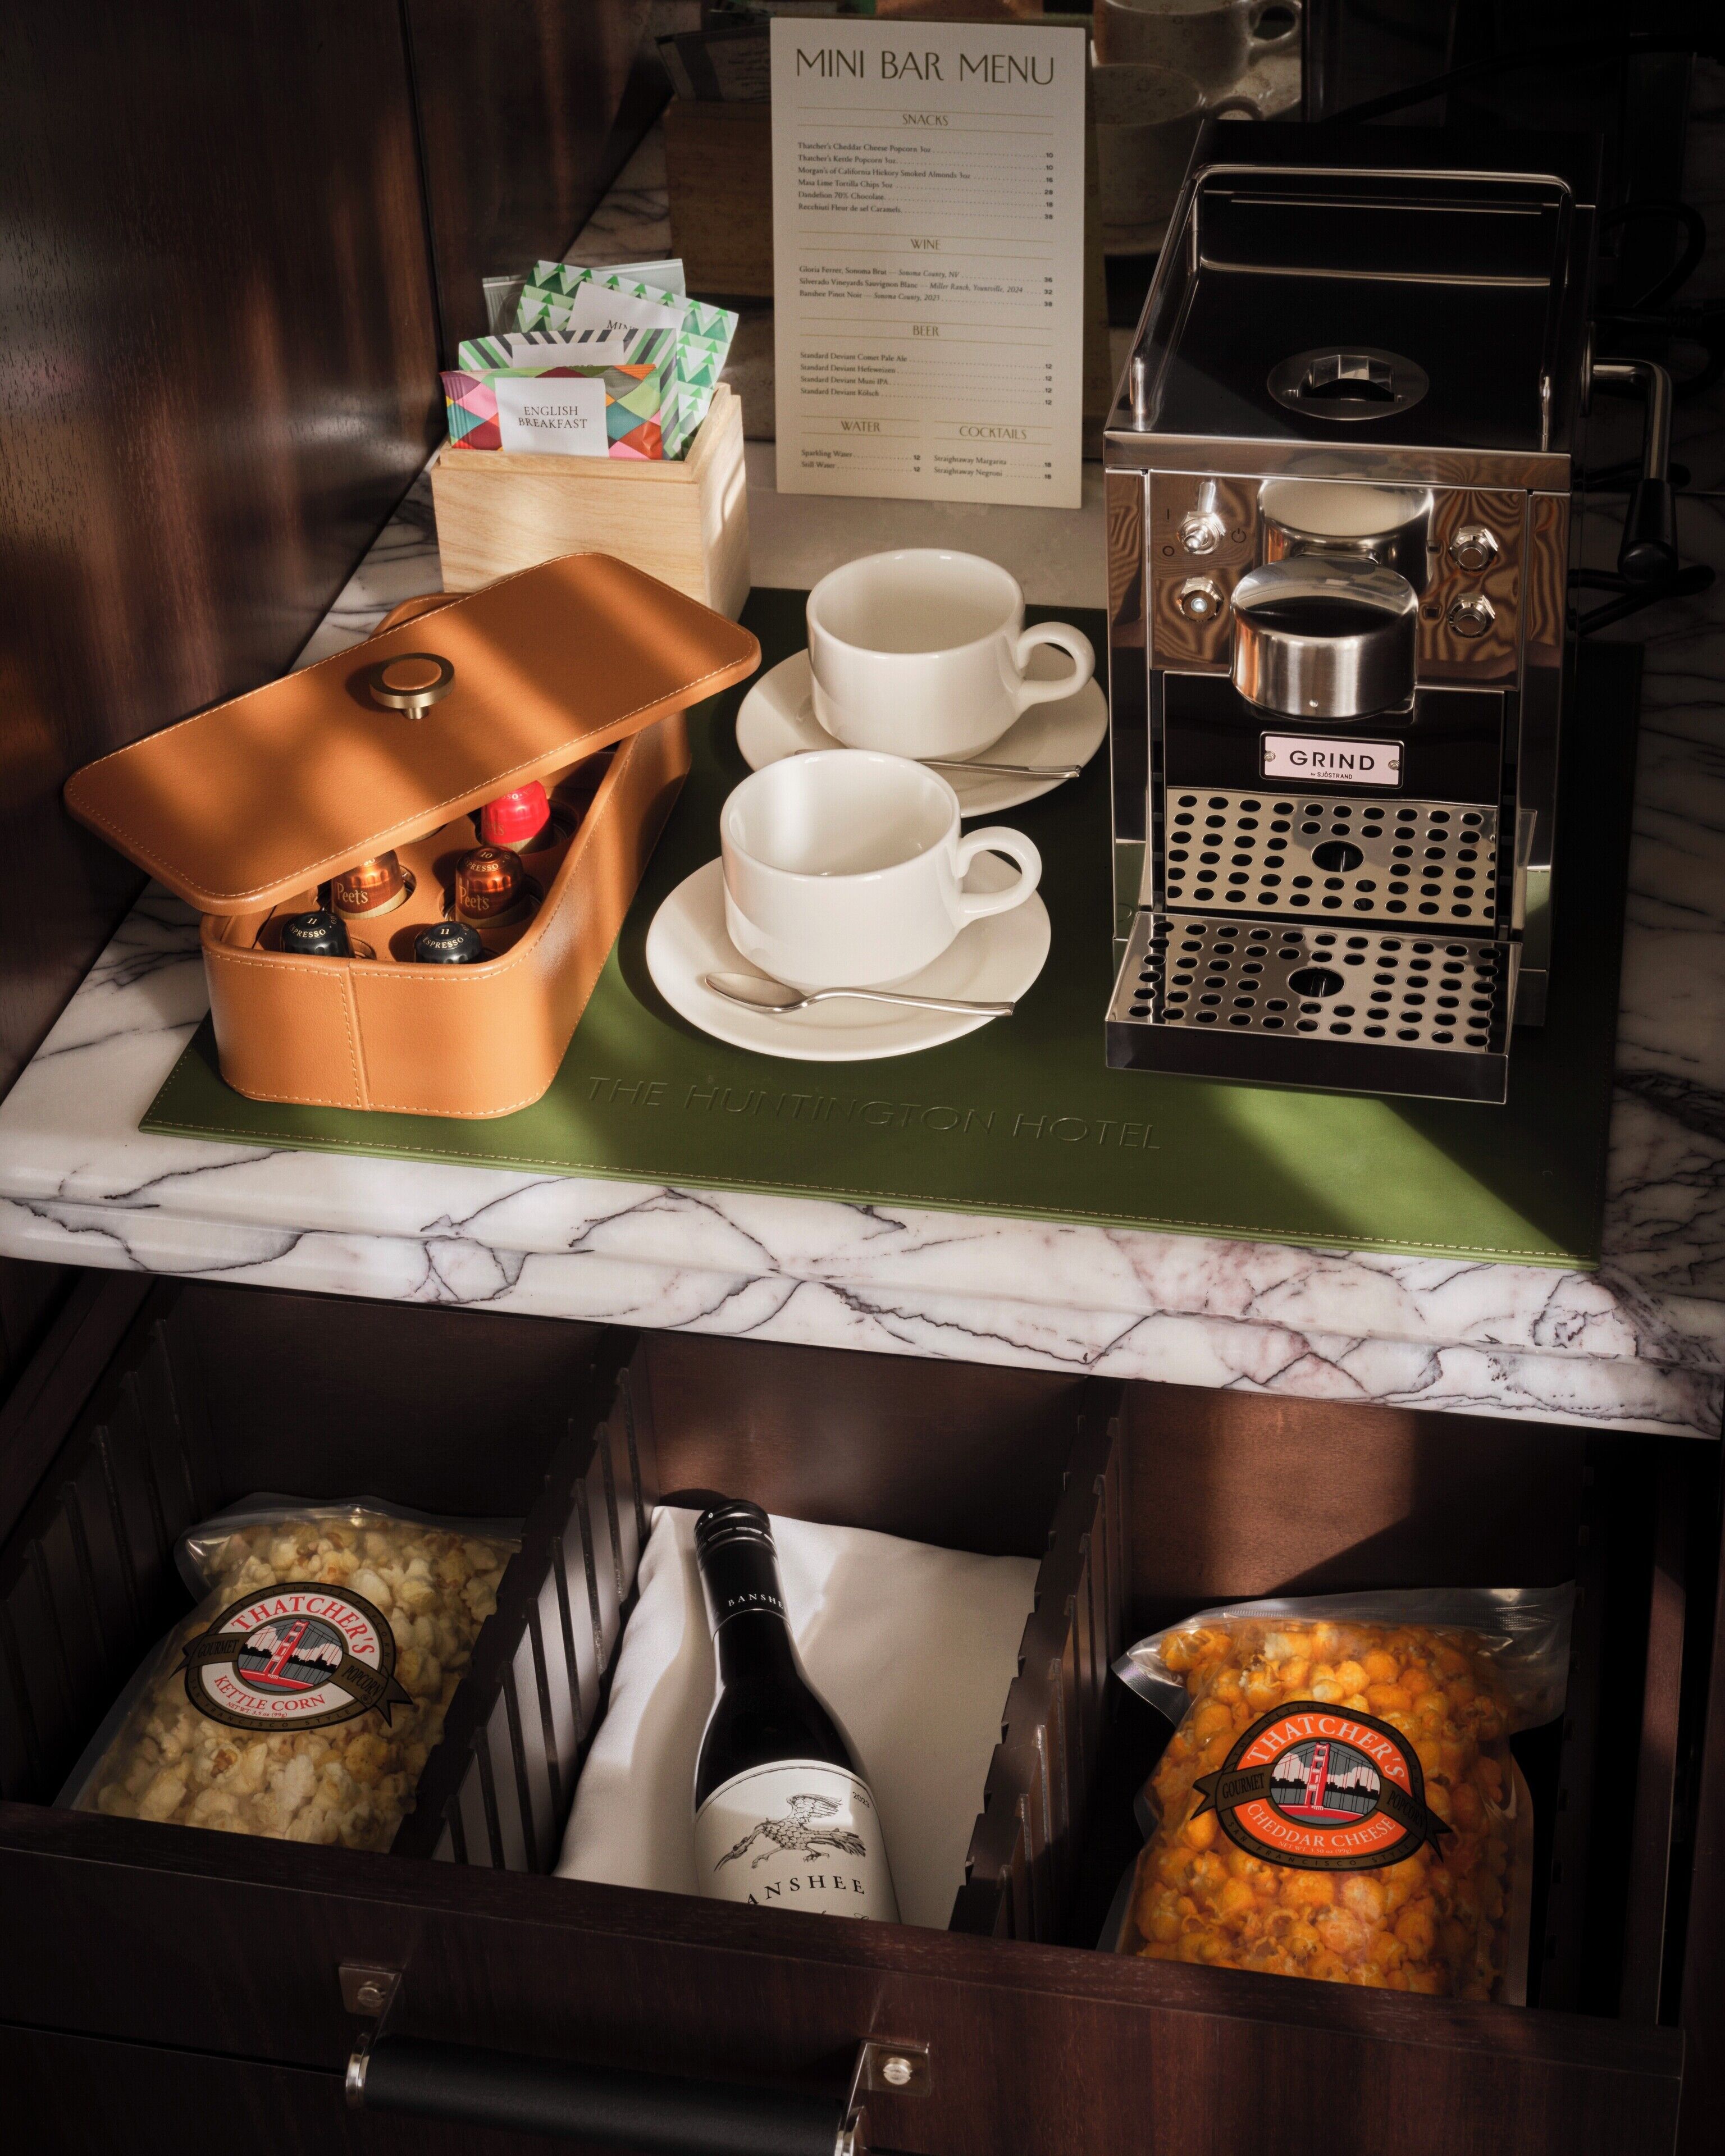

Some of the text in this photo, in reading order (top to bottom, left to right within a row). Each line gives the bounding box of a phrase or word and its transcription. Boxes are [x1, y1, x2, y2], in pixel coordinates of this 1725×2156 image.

[797, 48, 864, 78] MINI
[882, 51, 944, 81] BAR
[960, 53, 1053, 85] MENU
[902, 114, 948, 126] SNACKS
[890, 145, 918, 154] Popcorn
[855, 156, 882, 165] Popcorn
[798, 167, 828, 175] Morgan's
[873, 169, 898, 178] Hickory
[860, 181, 879, 189] Chips
[910, 239, 940, 250] WINE
[923, 270, 947, 278] County,
[831, 278, 863, 287] Vineyards
[865, 280, 898, 289] Sauvignon
[951, 283, 970, 291] Ranch,
[974, 284, 1004, 293] Yountville,
[898, 293, 921, 302] County,
[913, 325, 939, 337] BEER
[524, 406, 578, 416] ENGLISH
[518, 417, 587, 429] BREAKFAST
[841, 420, 880, 432] WATER
[959, 426, 1027, 440] COCKTAILS
[801, 449, 831, 459] Sparkling
[934, 455, 974, 465] Straightaway
[976, 457, 1007, 466] Margarita
[934, 467, 974, 477] Straightaway
[976, 469, 1003, 478] Negroni
[1289, 750, 1375, 771] GRIND
[1317, 771, 1353, 780] SJÖSTRAND
[336, 882, 369, 905] Peet's
[459, 885, 490, 911] Peet's
[423, 937, 464, 948] ESPRESSO
[588, 1076, 1161, 1150] THE HUNTINGTON HOTEL
[728, 1593, 784, 1609] BANSHE
[231, 1596, 375, 1654] THATCHER'S
[198, 1639, 239, 1659] GOURMET
[341, 1665, 385, 1697] POPCORN
[215, 1675, 325, 1711] KETTLE CORN
[204, 1702, 289, 1728] FRANCISCO
[305, 1709, 351, 1725] STYLE
[1246, 1716, 1405, 1778] THATCHER'S
[1222, 1773, 1265, 1799] GOURMET
[852, 1792, 870, 1808] 2023
[1387, 1790, 1426, 1829] POPCORN
[1248, 1803, 1397, 1847] CHEDDAR CHEESE
[1228, 1821, 1412, 1867] SAN FRANCISCO STYLE
[747, 1875, 865, 1905] ANSHEE
